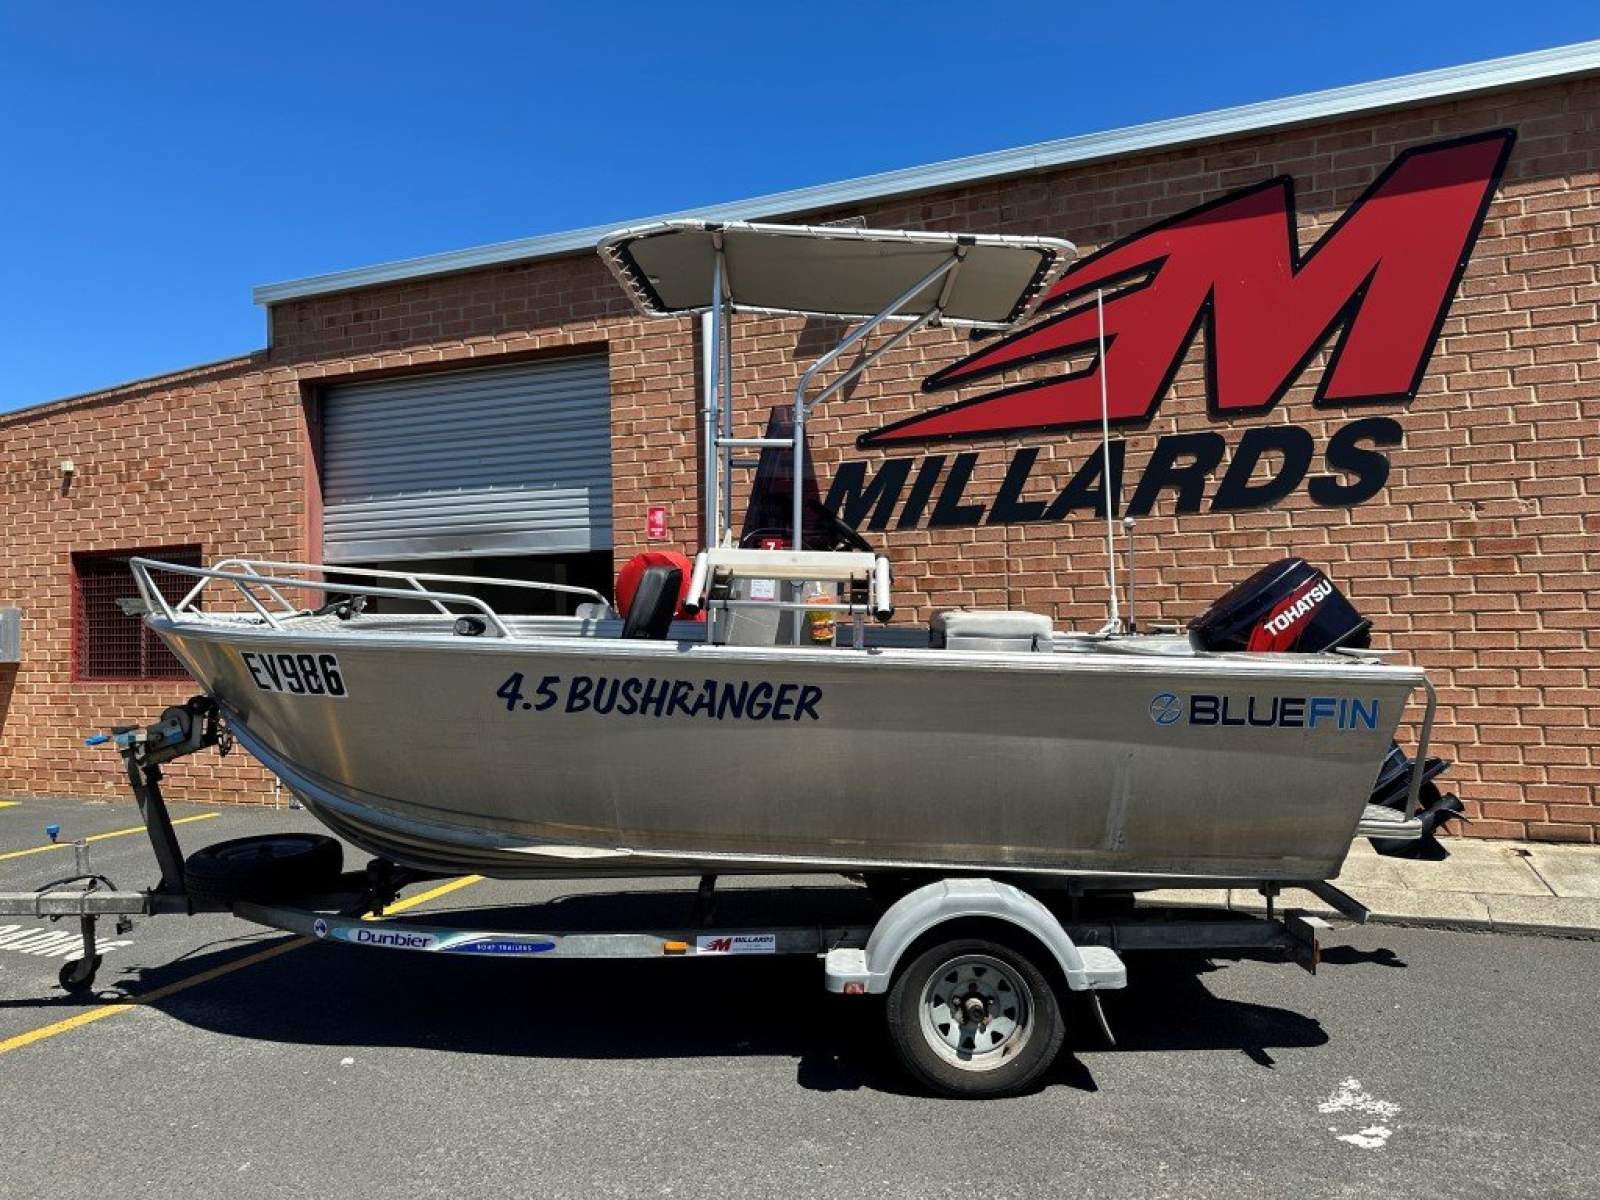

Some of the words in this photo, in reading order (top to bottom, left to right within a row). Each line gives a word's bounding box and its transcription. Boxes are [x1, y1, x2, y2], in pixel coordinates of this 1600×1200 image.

[821, 416, 1404, 531] MILLARDS
[1263, 579, 1333, 636] TOHATSU
[241, 652, 346, 696] EV986
[497, 671, 561, 712] 4.5
[565, 675, 823, 721] BUSHRANGER
[1188, 694, 1379, 729] BLUEFIN
[356, 929, 432, 948] Dunbier
